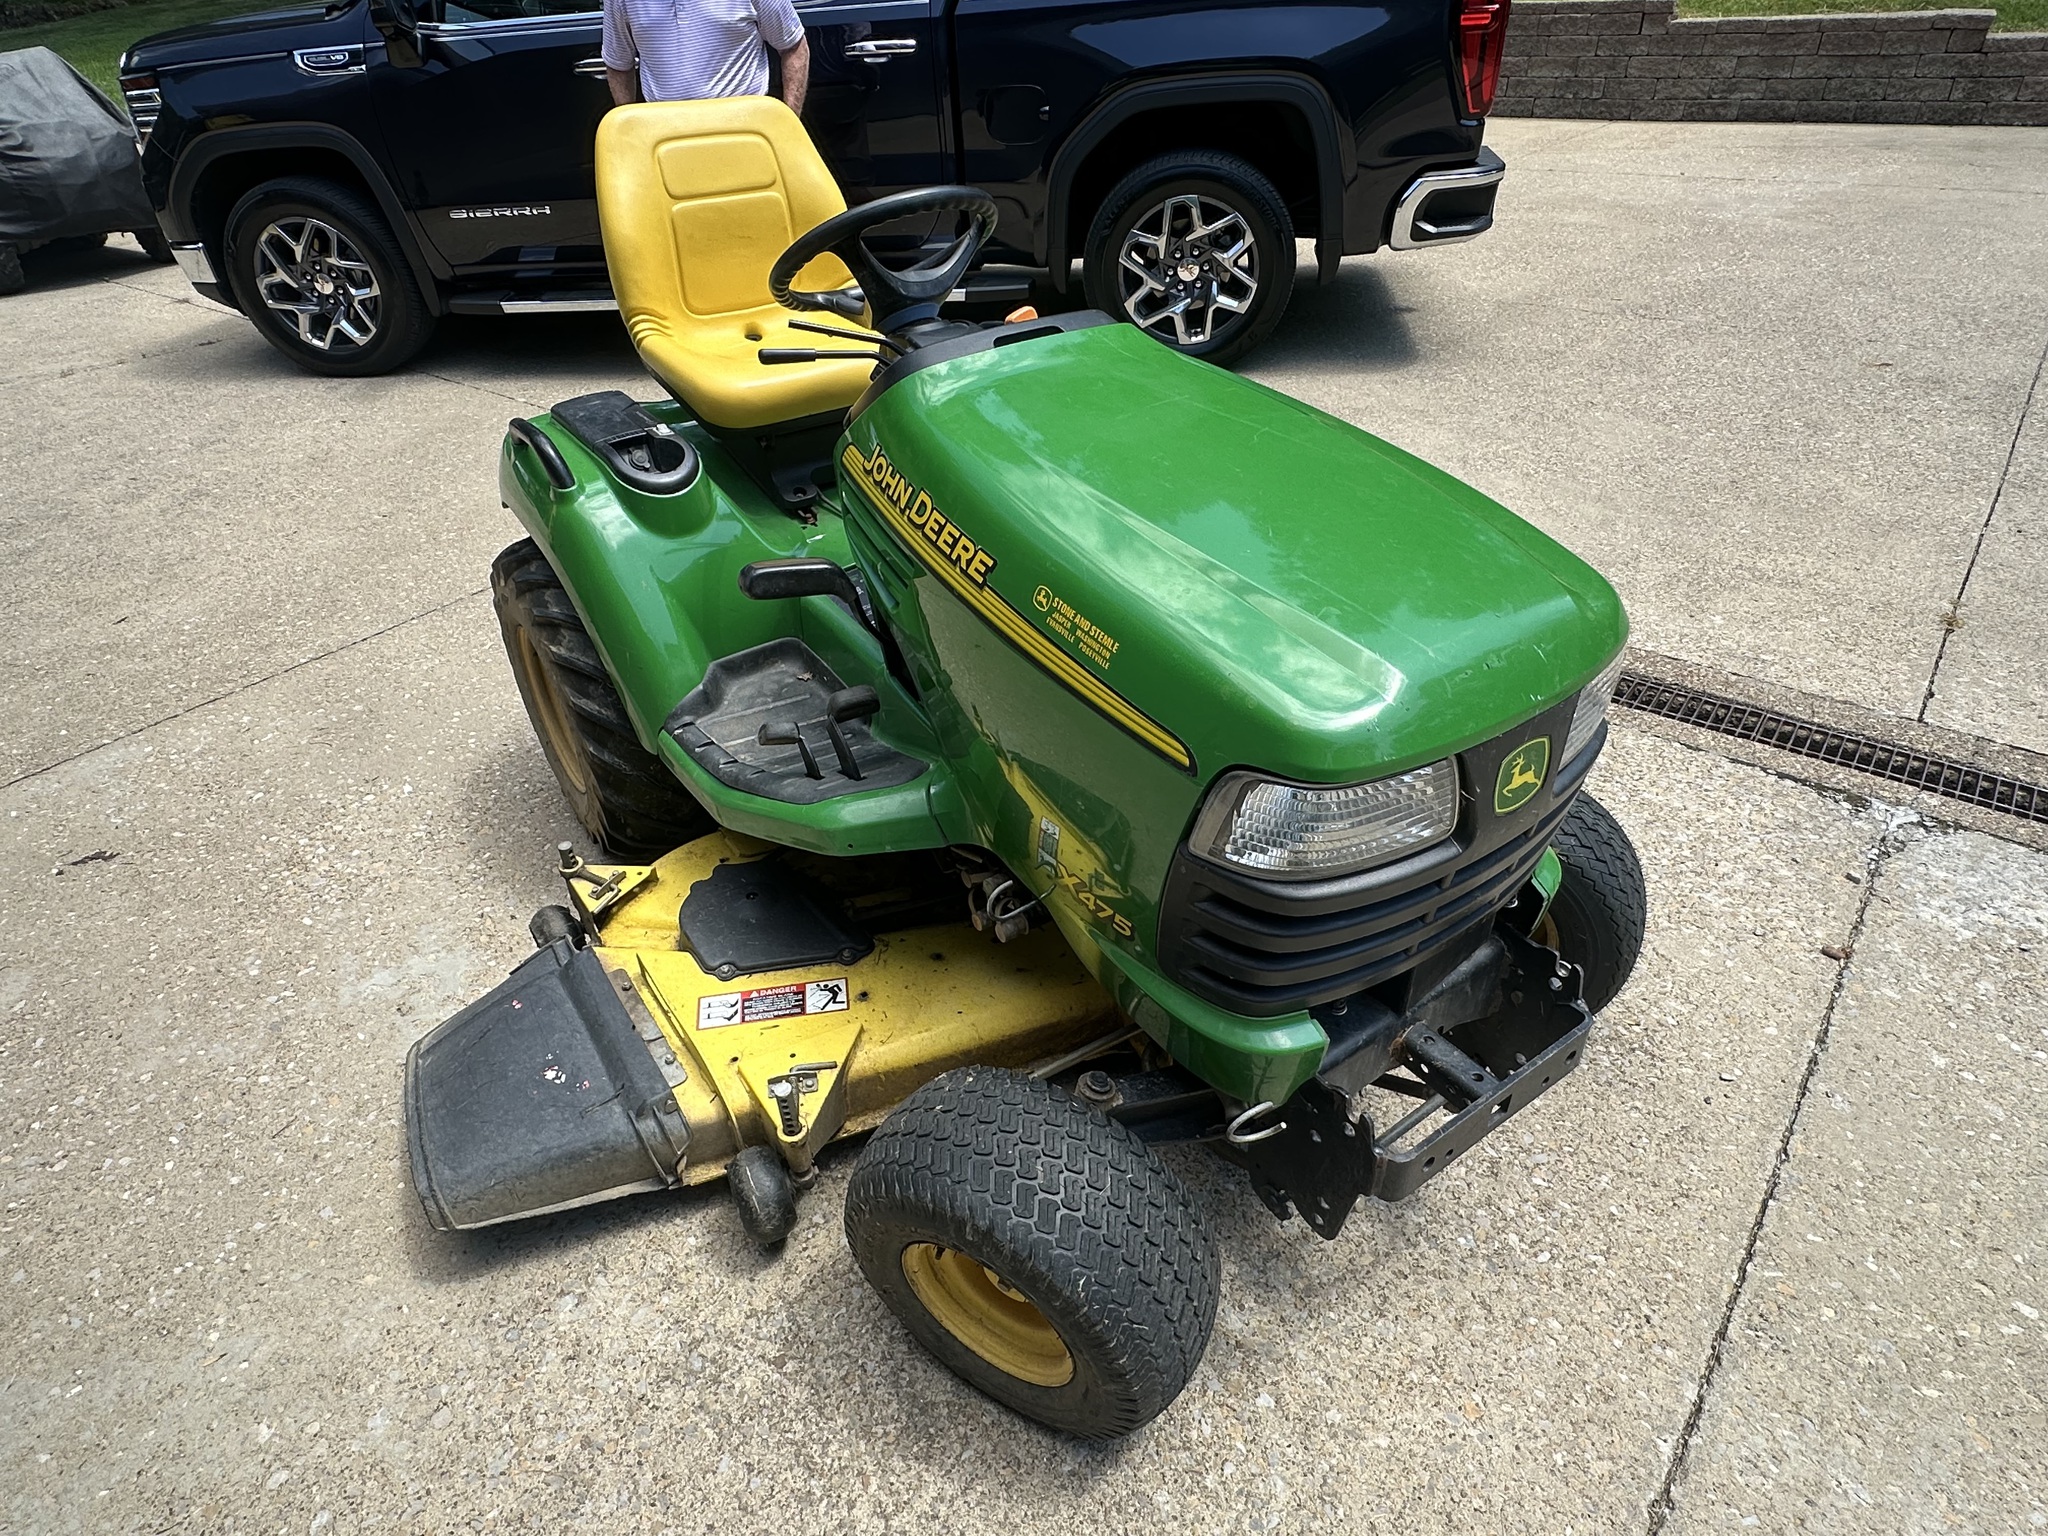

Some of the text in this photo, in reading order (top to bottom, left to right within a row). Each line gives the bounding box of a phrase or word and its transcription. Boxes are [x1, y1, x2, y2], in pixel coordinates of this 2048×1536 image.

[449, 205, 551, 219] SIERRA
[862, 444, 995, 585] JOHN DEERE
[1052, 597, 1120, 653] STONE AND STEMLE
[1075, 628, 1111, 659] WASHINGTON
[1057, 861, 1132, 936] X475
[760, 985, 797, 996] DANGER
